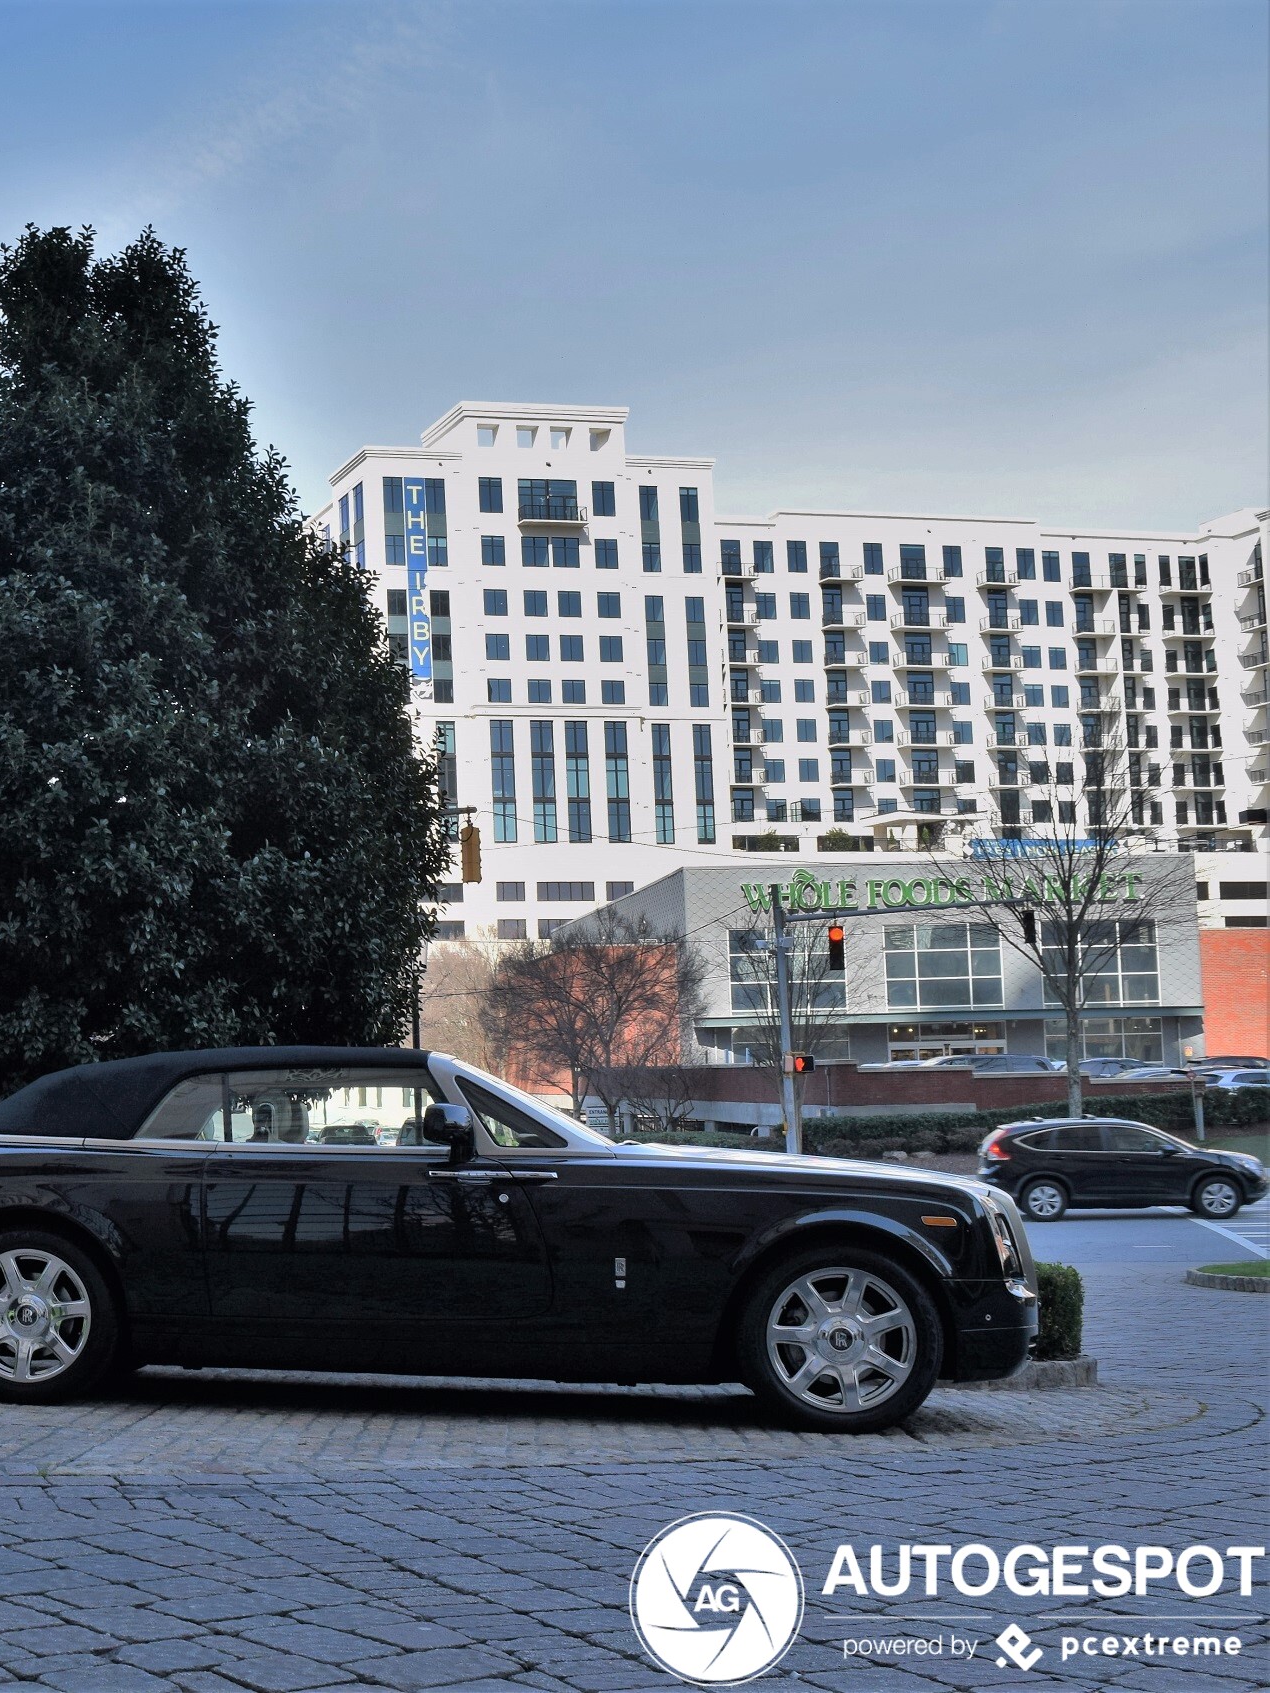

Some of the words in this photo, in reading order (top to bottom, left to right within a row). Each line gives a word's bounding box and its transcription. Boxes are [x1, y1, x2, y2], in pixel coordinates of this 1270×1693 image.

[406, 485, 425, 555] THE
[411, 572, 430, 666] IRBY
[740, 876, 859, 914] WHOLE
[866, 876, 977, 909] FOODS
[979, 871, 1143, 903] MARKET
